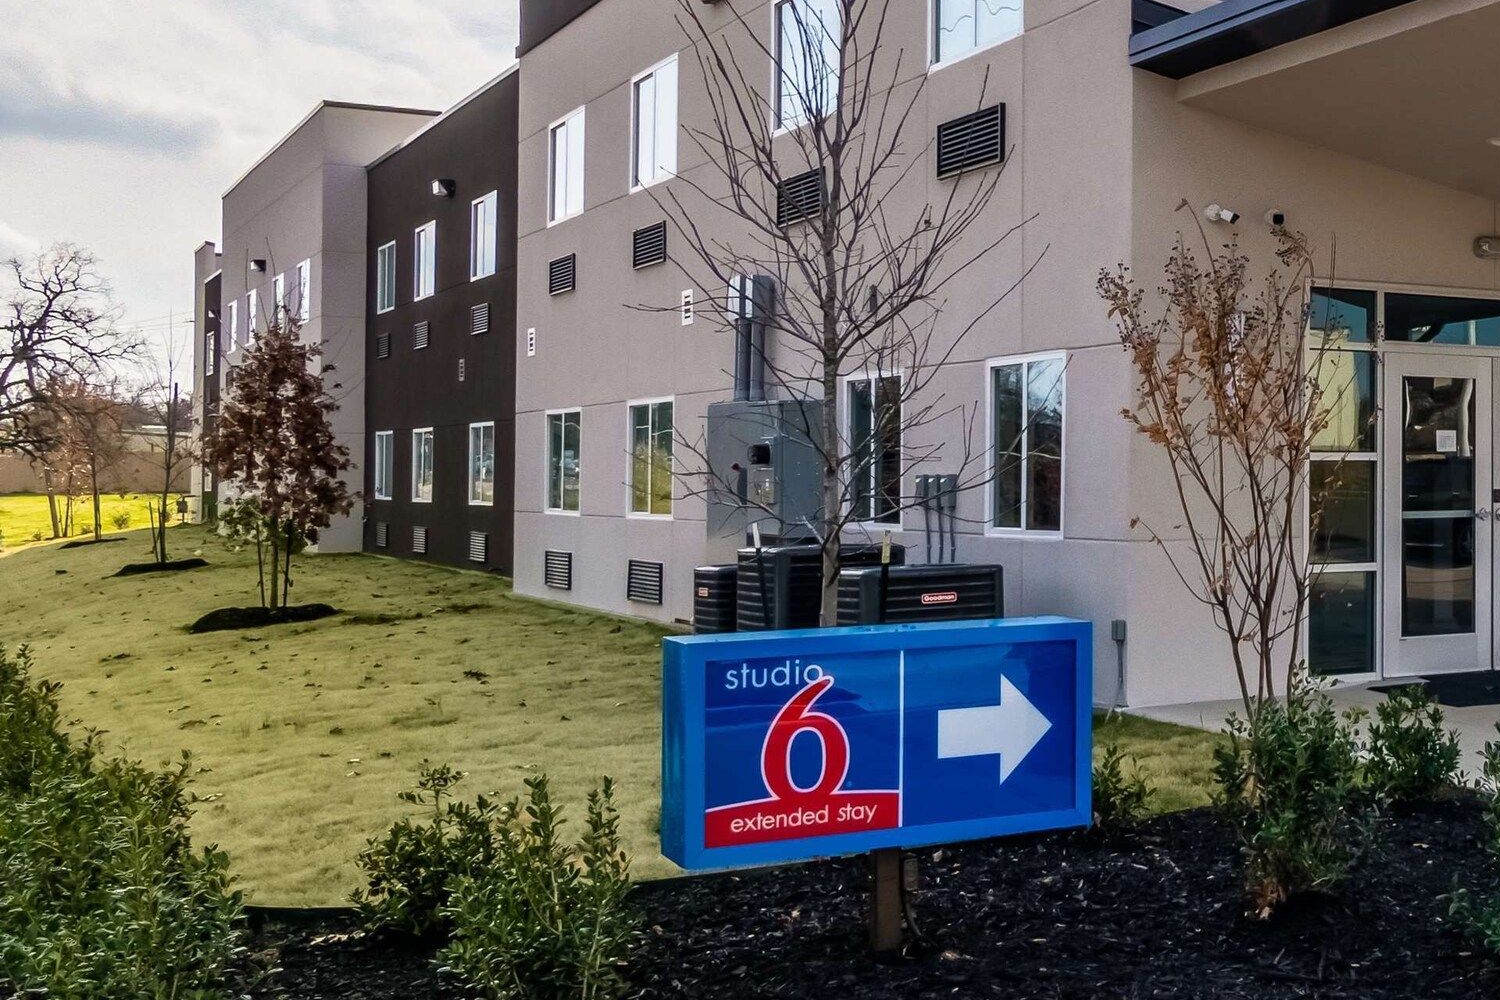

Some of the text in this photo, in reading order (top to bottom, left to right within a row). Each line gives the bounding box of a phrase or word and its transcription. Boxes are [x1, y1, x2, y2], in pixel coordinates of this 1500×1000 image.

[725, 659, 823, 690] studio
[761, 675, 850, 800] 6
[730, 802, 878, 833] extended stay
